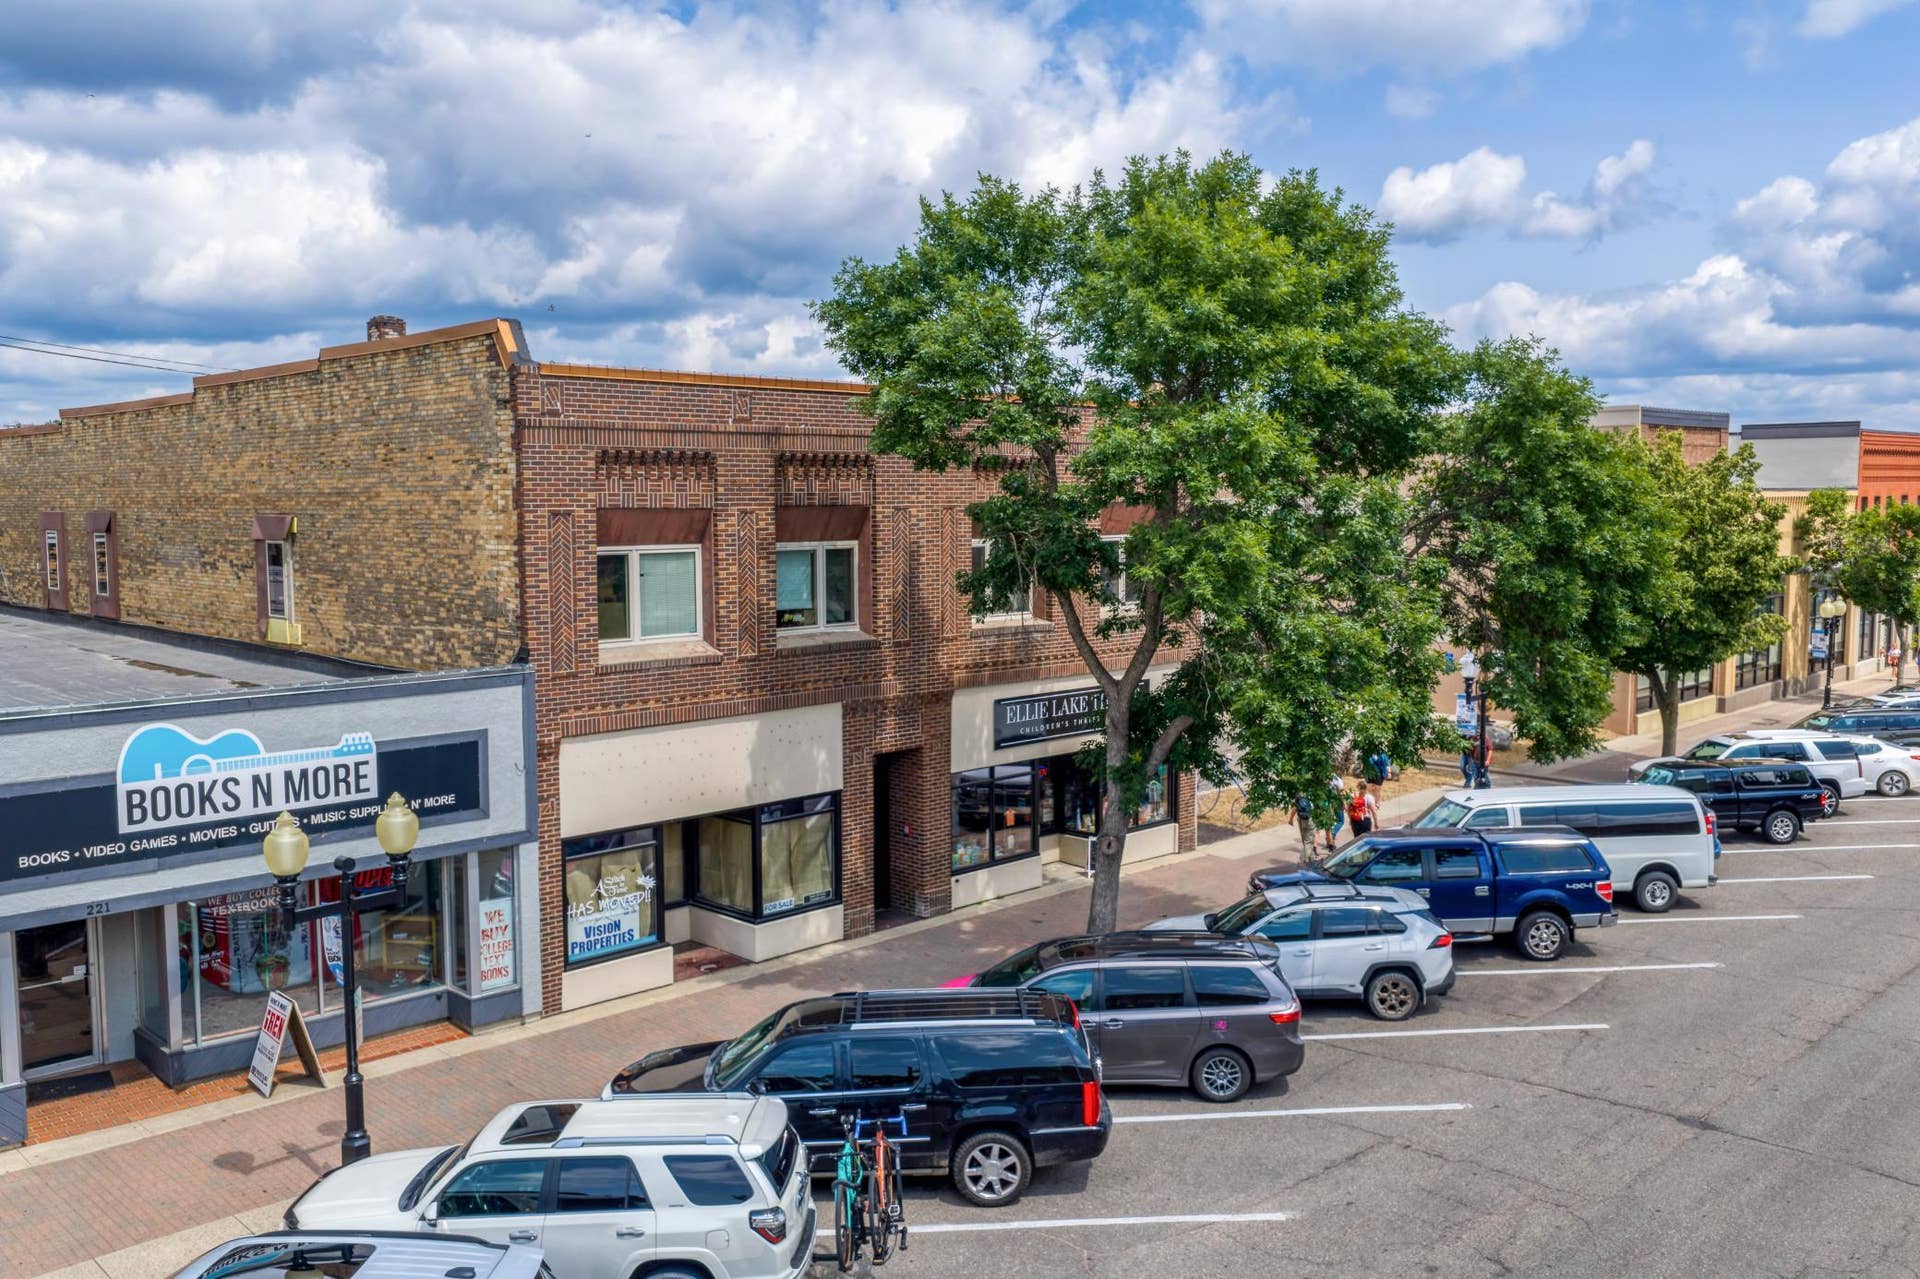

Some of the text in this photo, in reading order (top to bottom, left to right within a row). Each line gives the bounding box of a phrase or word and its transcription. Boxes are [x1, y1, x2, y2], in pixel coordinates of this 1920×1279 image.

[1006, 701, 1049, 724] ELLIE
[1051, 695, 1088, 717] LAKE
[125, 759, 371, 826] BOOKS N MORE
[18, 850, 70, 868] BOOKS
[83, 842, 126, 858] VIDEO
[130, 834, 178, 851] GAMES
[189, 826, 238, 843] MOVIES
[249, 816, 300, 834] GUITS
[310, 810, 347, 825] MUSIC
[424, 794, 456, 808] MORE
[87, 902, 110, 915] 221
[567, 900, 594, 918] HAS
[764, 899, 794, 913] FOR SALE
[485, 909, 505, 924] WE
[481, 924, 509, 942] BUY
[584, 919, 622, 940] VISION
[570, 928, 635, 955] PROPERTIES
[480, 966, 510, 982] BOOKS
